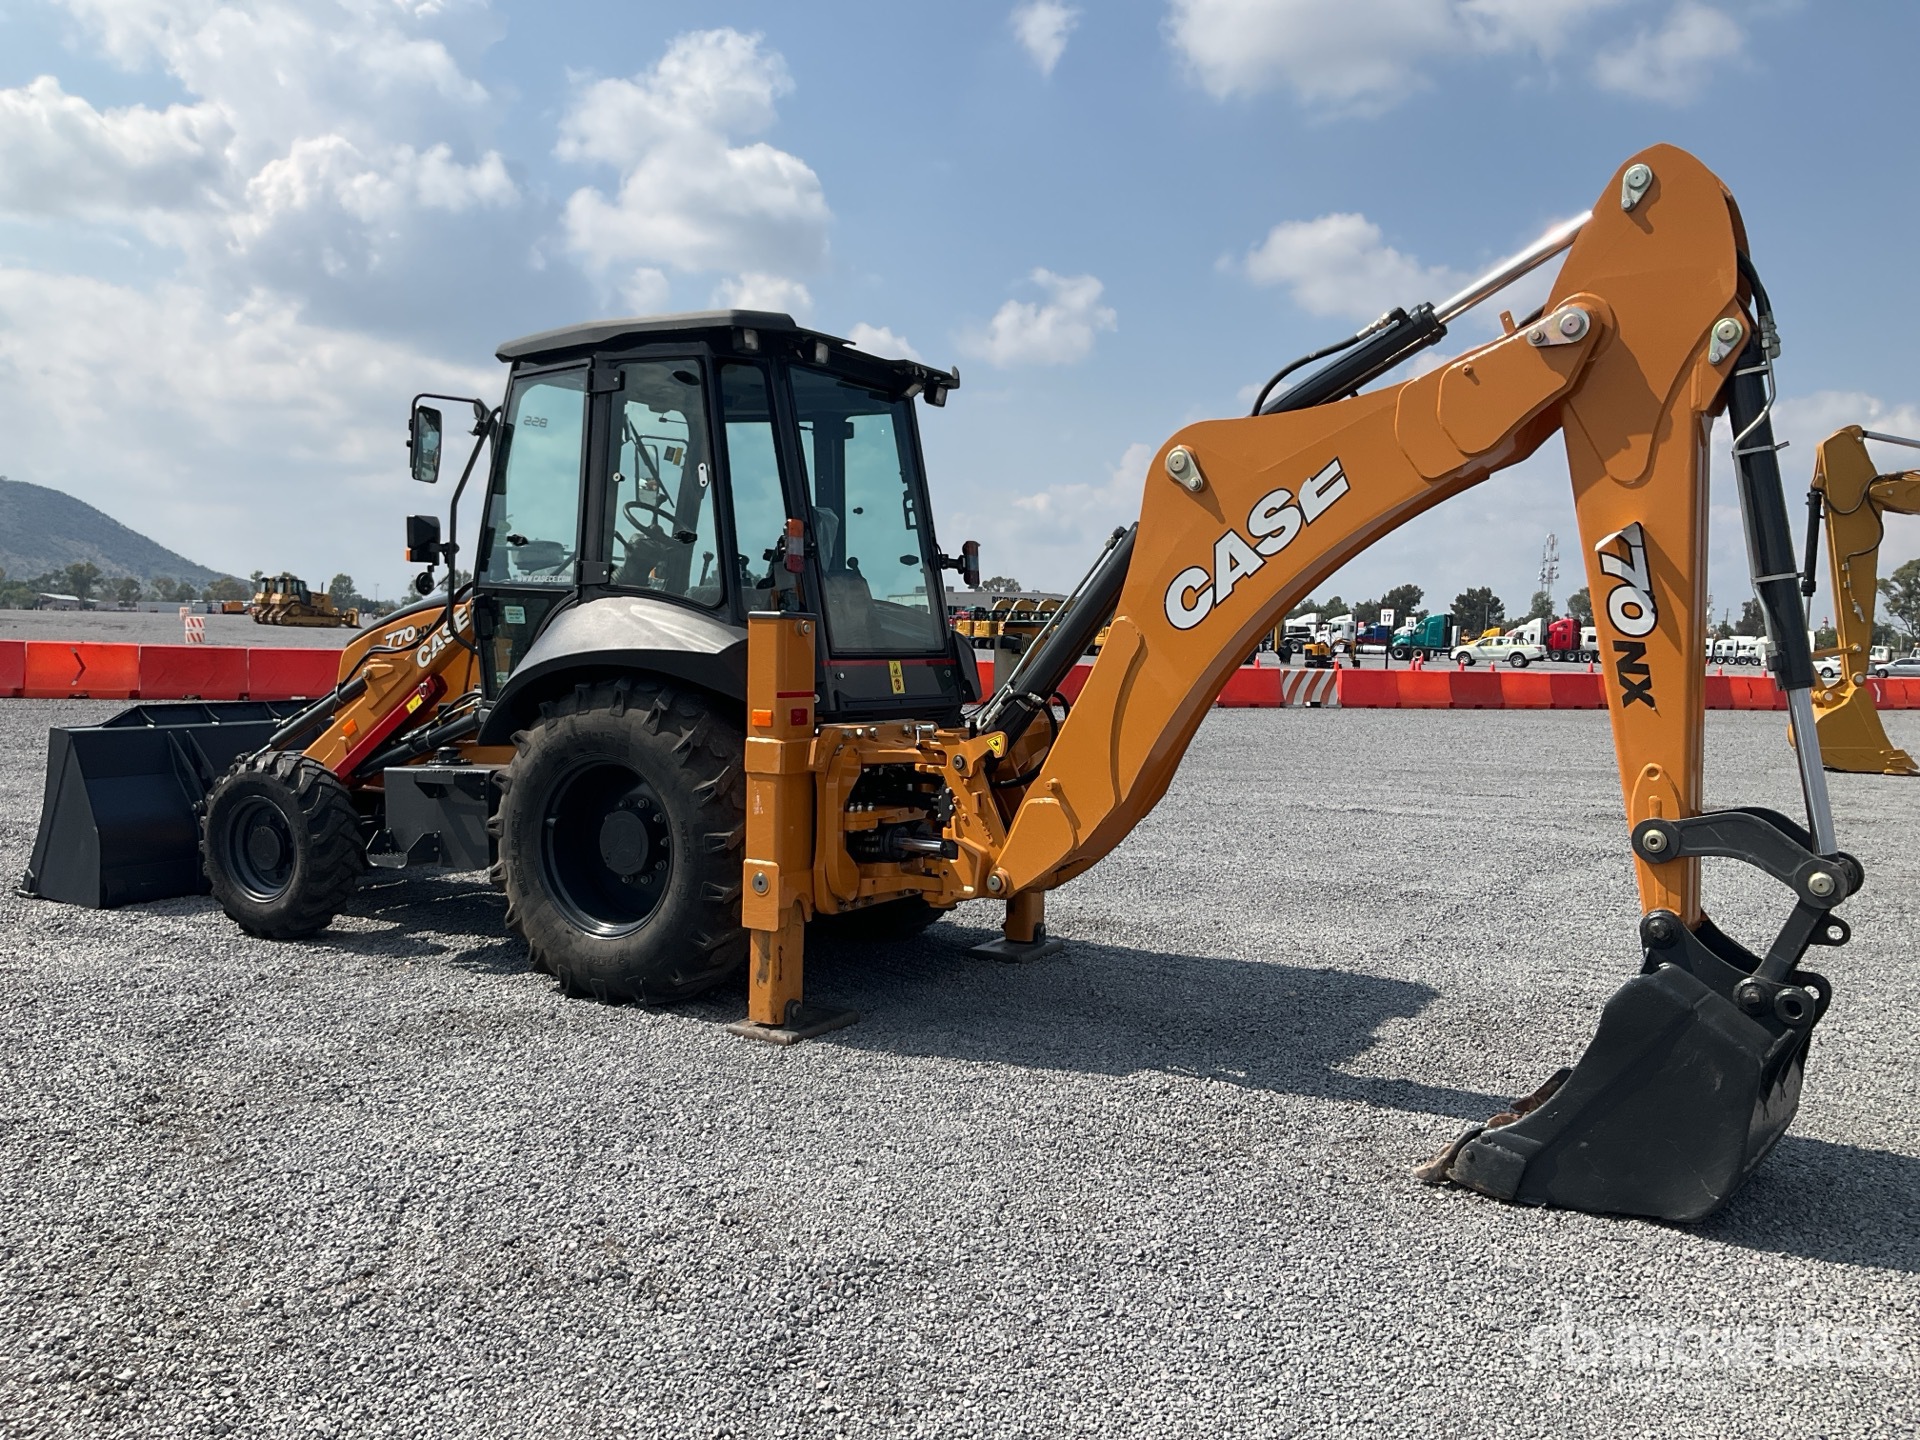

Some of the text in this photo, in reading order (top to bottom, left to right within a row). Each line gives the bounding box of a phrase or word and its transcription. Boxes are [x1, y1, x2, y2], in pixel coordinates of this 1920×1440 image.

[1164, 456, 1351, 631] CASE
[385, 625, 416, 649] 770
[416, 606, 471, 668] CASE
[1383, 614, 1392, 622] 17
[1595, 521, 1658, 709] 70 NX
